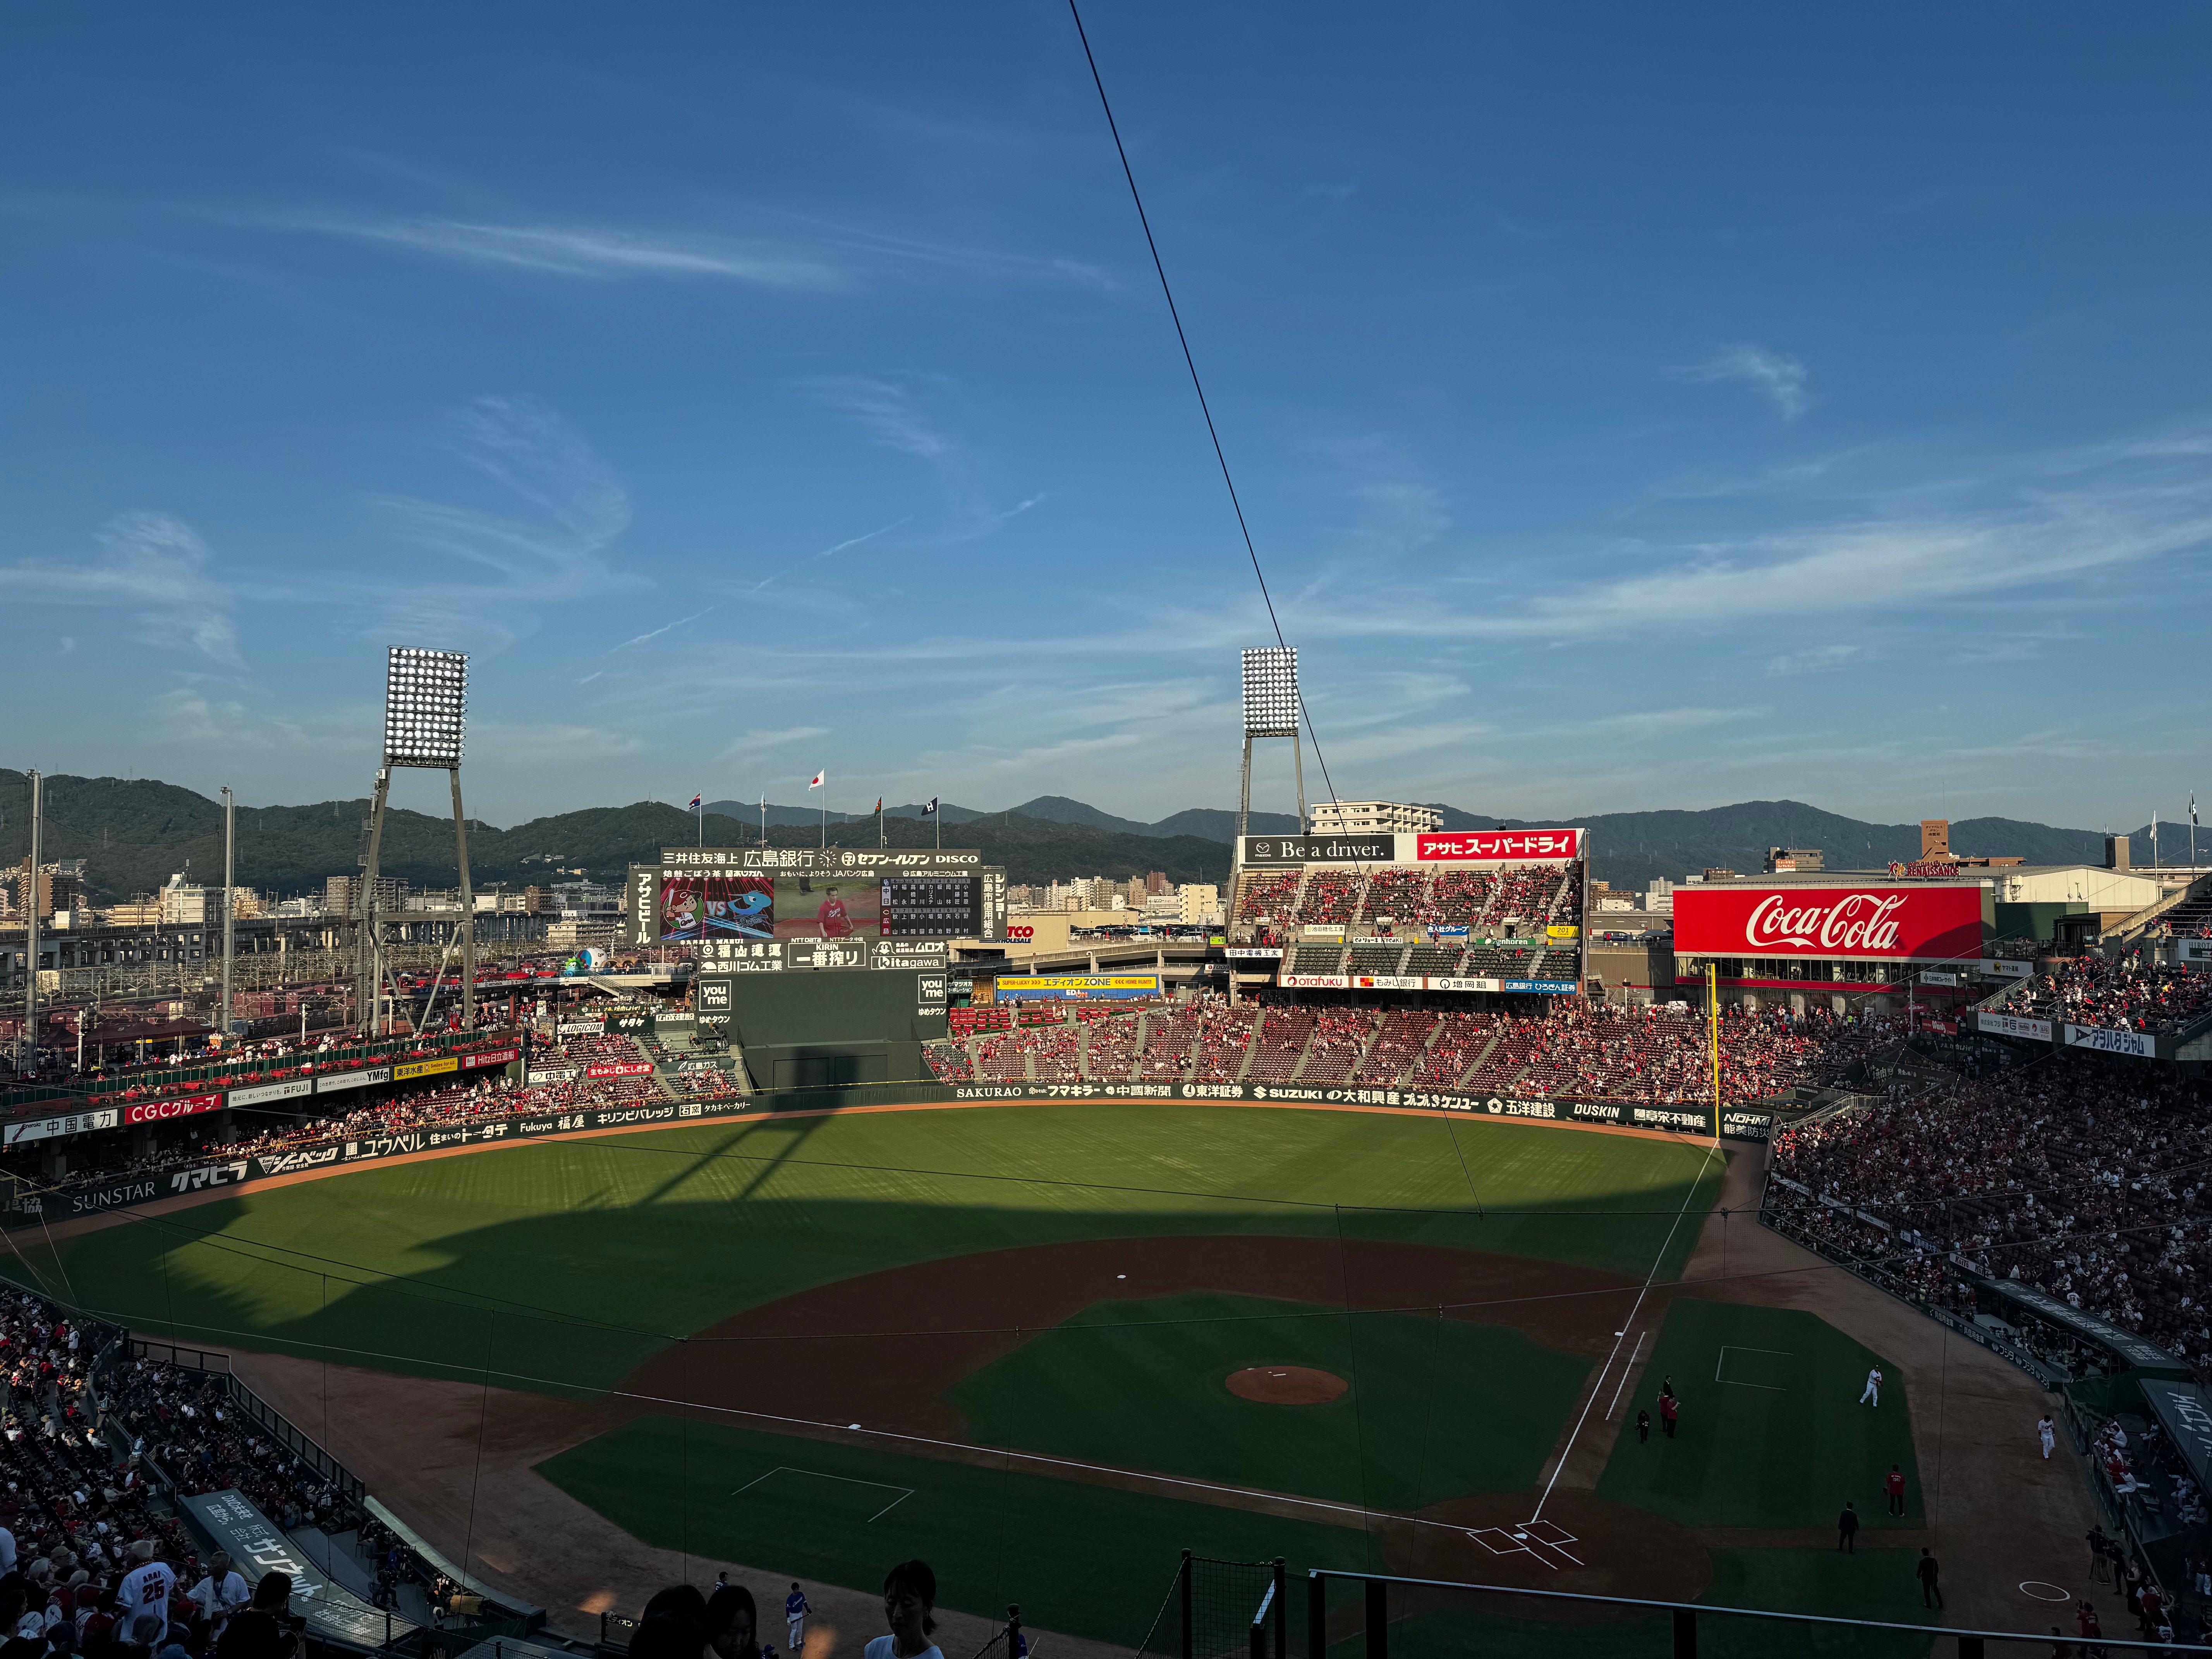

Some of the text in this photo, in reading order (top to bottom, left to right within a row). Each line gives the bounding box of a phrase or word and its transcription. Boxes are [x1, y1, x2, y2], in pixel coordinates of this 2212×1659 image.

[1281, 841, 1384, 857] Be a driver.
[1424, 836, 1569, 855] アサヒ スーパードライ
[663, 853, 738, 864] 三井住友海上
[744, 850, 815, 867] 広島銀行
[1907, 866, 1960, 876] RENAISSANCE
[636, 873, 652, 944] アサヒビール
[706, 901, 726, 915] VS
[984, 874, 993, 938] 広島市信用組合
[883, 918, 889, 934] 広島
[893, 914, 898, 934] 秋山
[902, 914, 907, 934] 上本
[1746, 894, 1908, 949] Coca-Cola
[915, 942, 945, 953] ムロオ
[796, 950, 858, 966] 一番搾り
[878, 957, 939, 968] Kitagawa
[718, 960, 782, 972] 西川ゴム工業
[922, 980, 942, 991] you
[1376, 979, 1416, 987] もみじ銀行
[1535, 983, 1575, 991] ひろぎん証券
[703, 986, 726, 997] you
[926, 989, 943, 997] me
[708, 996, 727, 1005] me
[656, 1013, 695, 1022] 広成建設
[918, 1008, 946, 1016] ゆめタウン
[619, 1018, 645, 1027] サタケ
[699, 1015, 730, 1024] ゆめタウン
[567, 1022, 603, 1032] LOGICOM
[2092, 1030, 2144, 1054] アヲハタ ジャム
[478, 1051, 515, 1065] Hitz日立造船
[397, 1065, 423, 1077] 東洋水産
[590, 1065, 650, 1076] 生もみじ にしき堂
[687, 1061, 718, 1070] 広島ガス
[367, 1070, 388, 1082] YMfg
[290, 1084, 308, 1093] FUJI
[957, 1087, 1022, 1098] SAKURAO
[1048, 1085, 1100, 1097] フマキラー
[1116, 1085, 1171, 1097] 中國新聞
[1196, 1085, 1243, 1098] 東洋証券
[1269, 1088, 1322, 1099] SUZUKI
[1343, 1089, 1400, 1105] 大和興産
[132, 1094, 216, 1122] CGCグループ
[704, 1102, 751, 1112] タカキベーカリー
[1506, 1100, 1555, 1118] 五洋建設
[1574, 1104, 1620, 1118] DUSKIN
[598, 1107, 673, 1124] キリンビバレッジ
[1645, 1110, 1706, 1127] 章栄不動産
[1724, 1113, 1771, 1126] NOHMI
[47, 1111, 111, 1135] 中国電力
[520, 1114, 584, 1133] Fukuya 福屋
[1724, 1123, 1770, 1138] 能美防災
[361, 1132, 425, 1158] ユウベル
[429, 1132, 461, 1145] 住まいの
[270, 1147, 339, 1174] ジーベック
[171, 1160, 247, 1192] クマヒラ
[72, 1181, 155, 1212] SUNSTAR
[1999, 1345, 2014, 1360] フジタ
[221, 1495, 254, 1520] DXの未来を
[143, 1579, 165, 1604] 25
